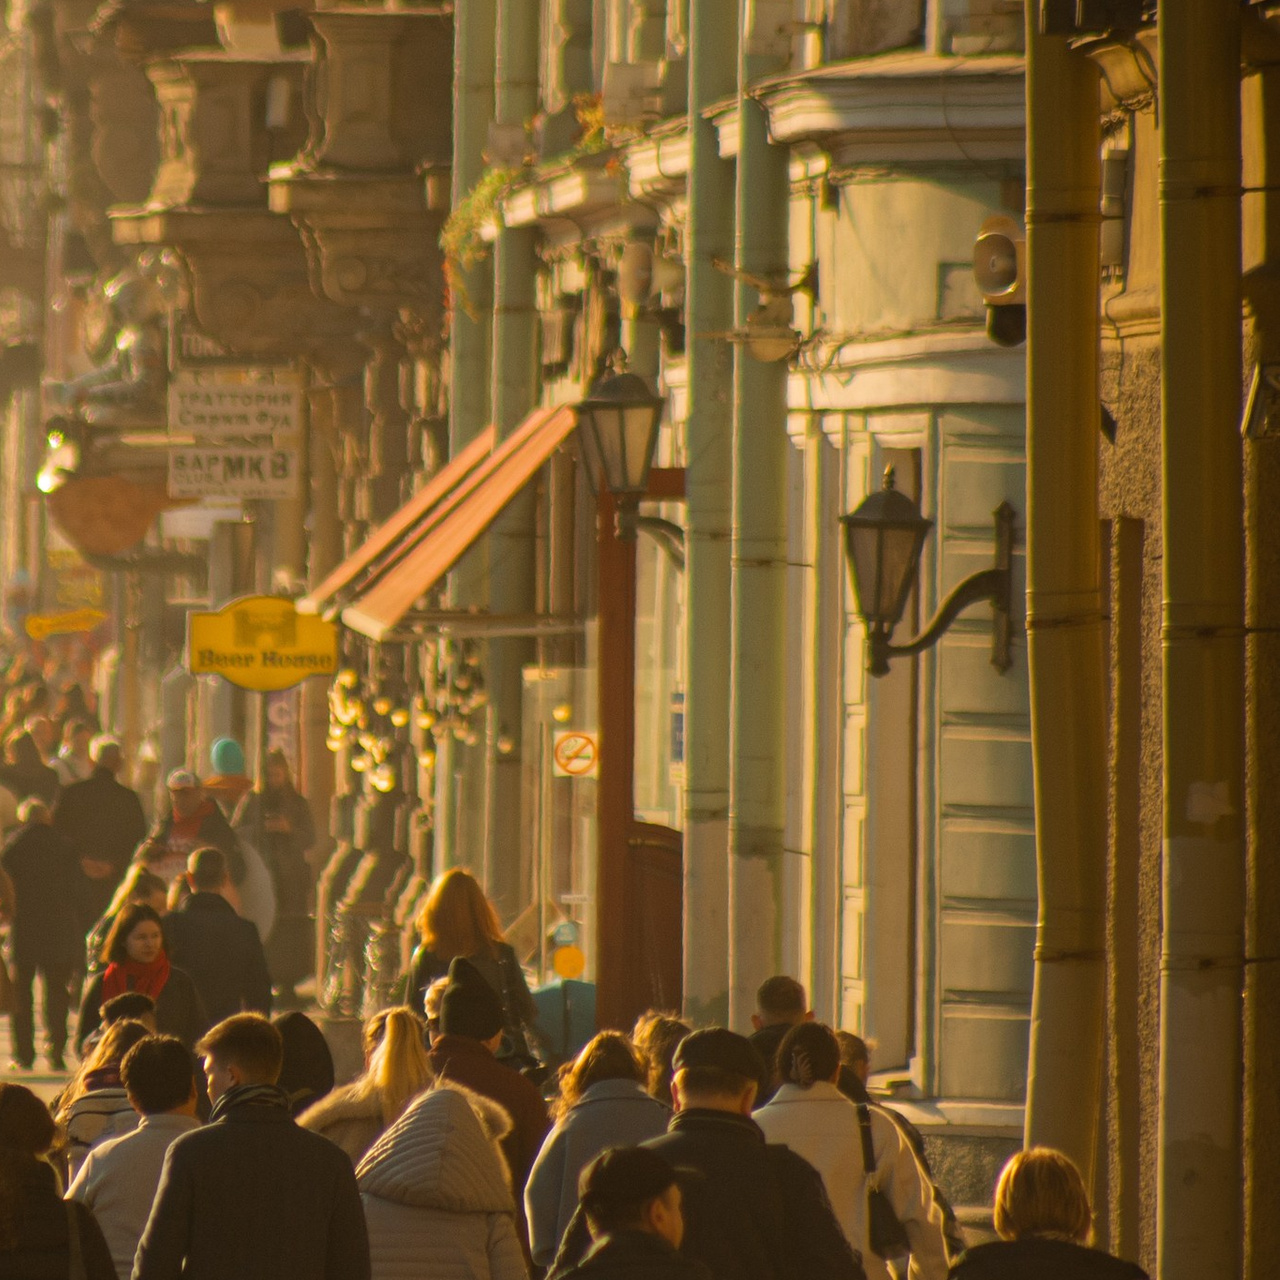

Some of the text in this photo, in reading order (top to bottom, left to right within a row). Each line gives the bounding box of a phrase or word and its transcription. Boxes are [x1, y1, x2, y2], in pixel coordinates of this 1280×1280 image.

[178, 392, 292, 406] ТРАТТОРИЯ
[197, 648, 333, 669] Beer House
